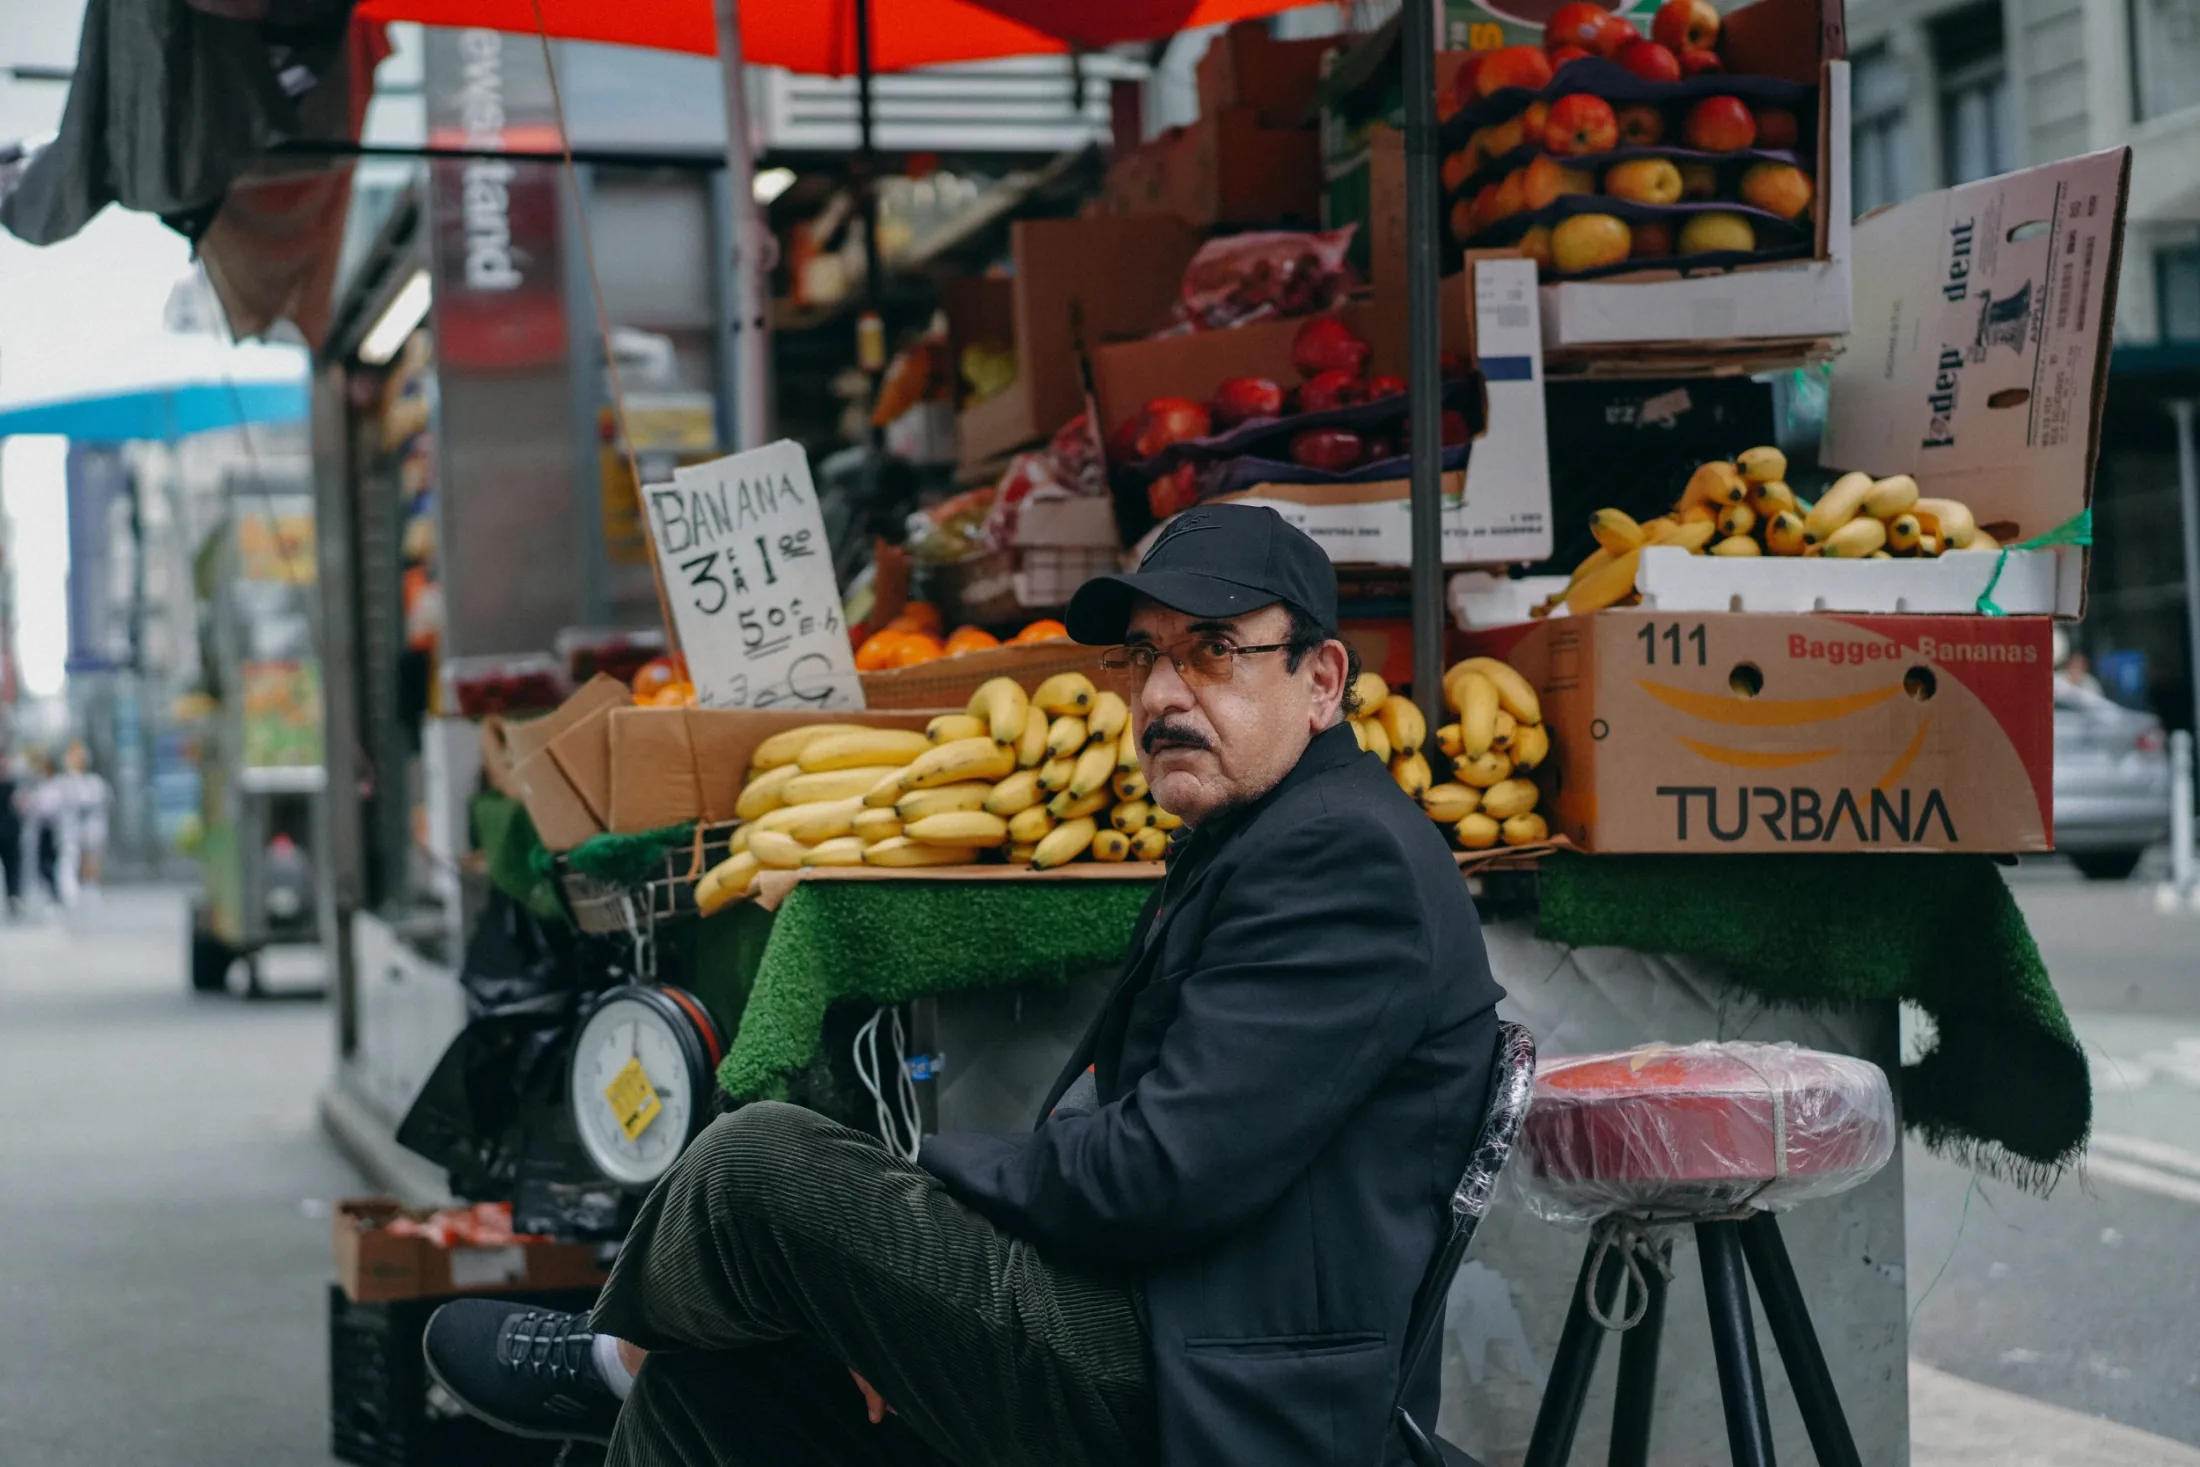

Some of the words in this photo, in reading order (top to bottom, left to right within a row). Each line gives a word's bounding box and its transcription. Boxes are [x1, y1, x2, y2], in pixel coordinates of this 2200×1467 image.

[460, 29, 521, 291] ewsstand
[652, 473, 805, 555] BANANA
[680, 552, 728, 615] 3
[1636, 622, 1707, 666] 111
[1787, 633, 1902, 665] Bagged
[1918, 636, 2038, 664] Bananas
[1656, 786, 1959, 842] TURBANA
